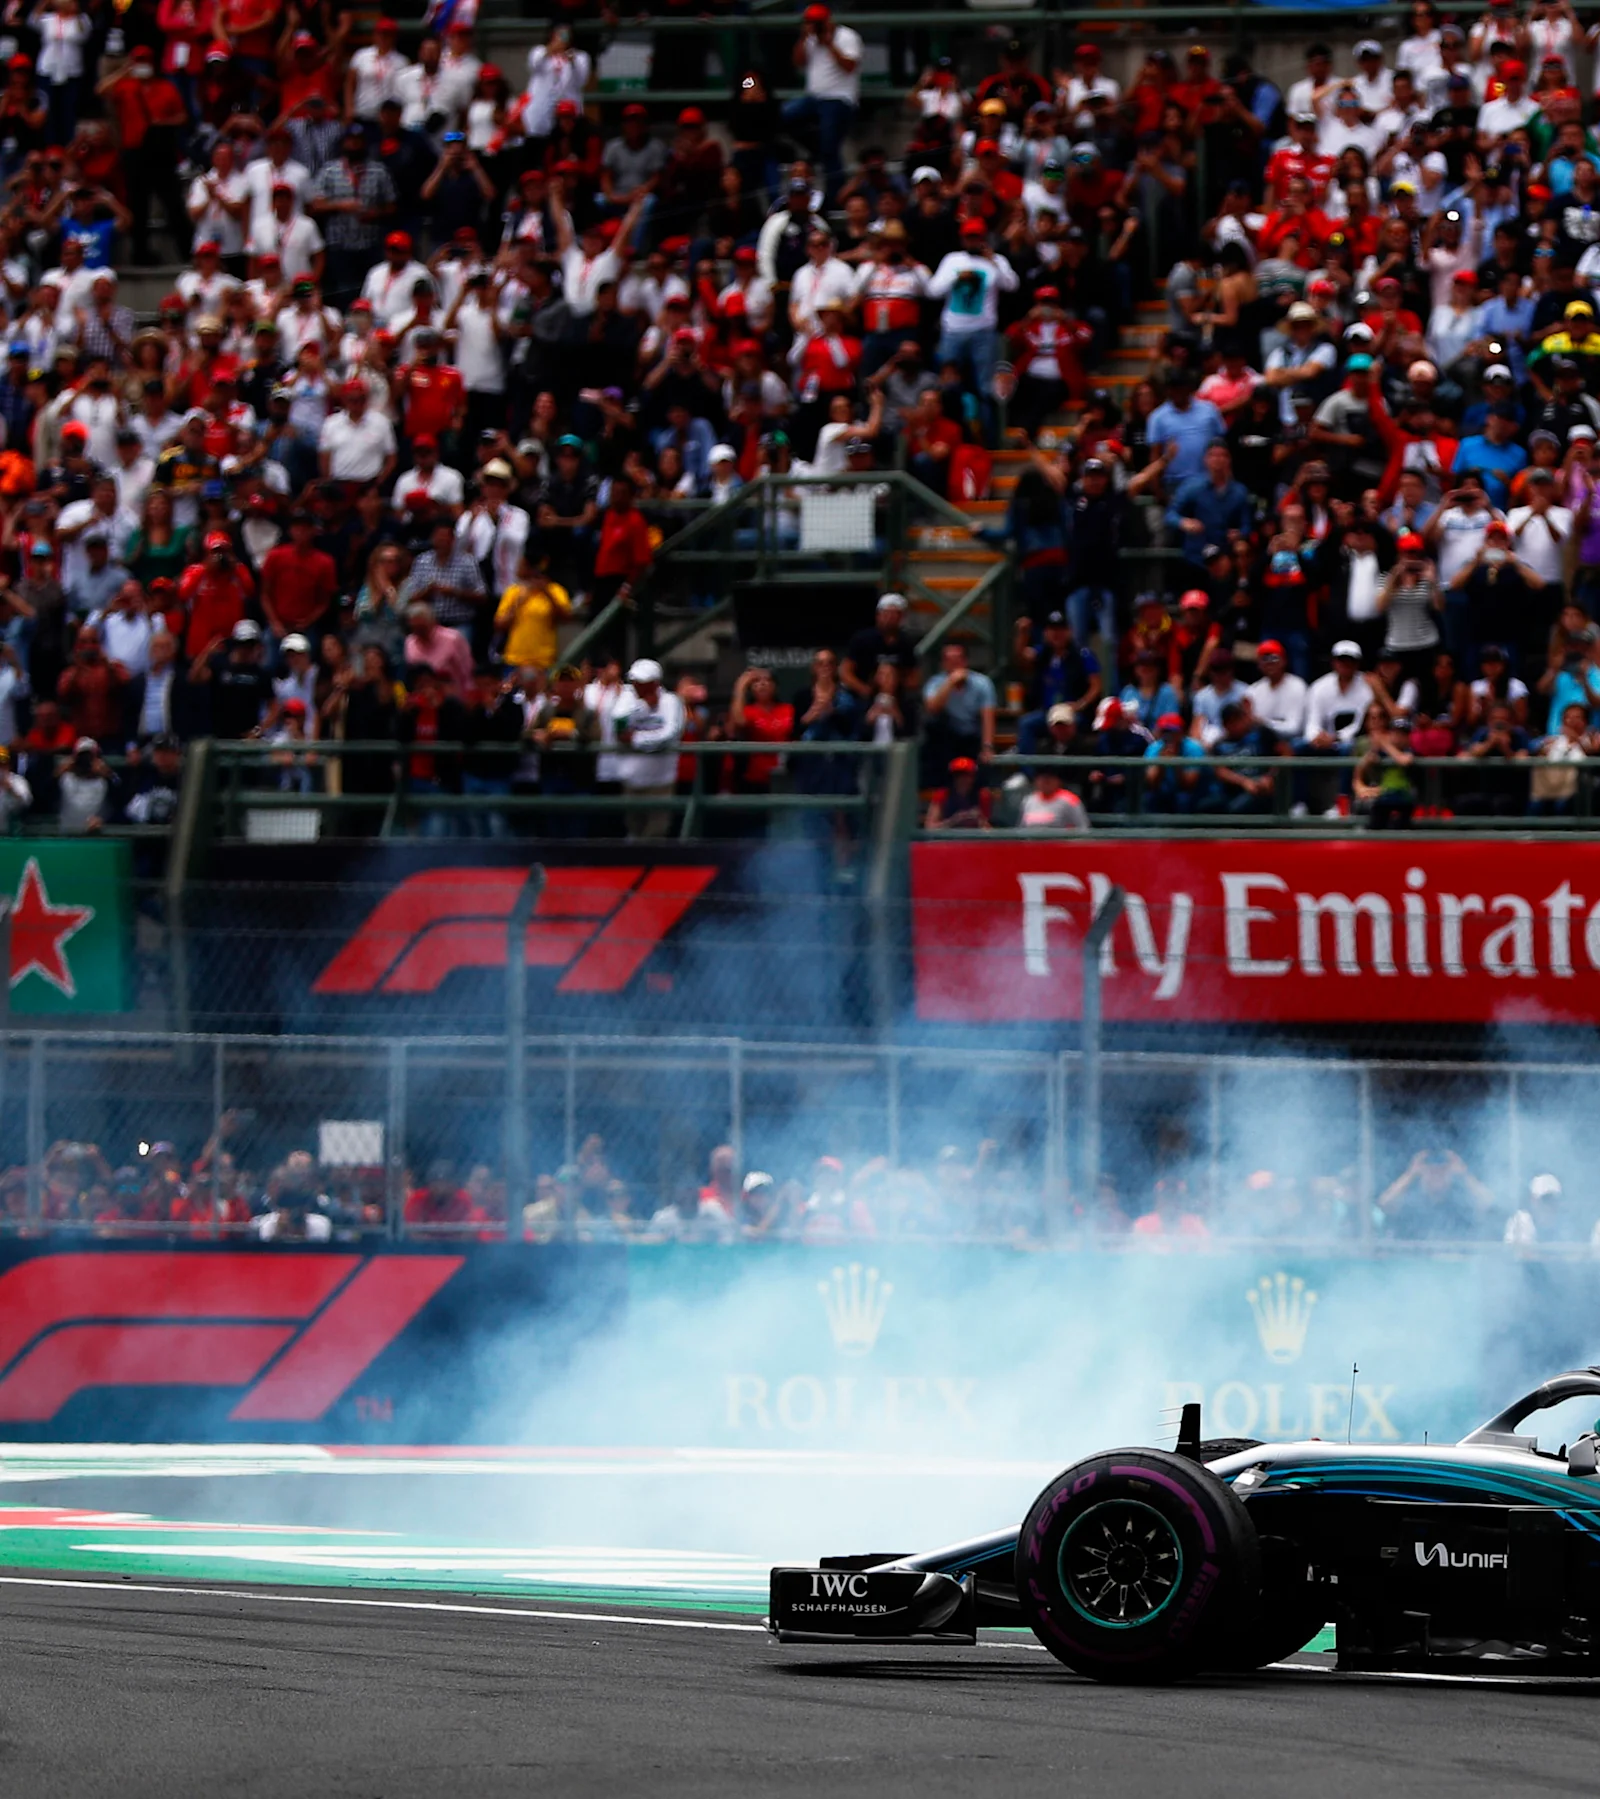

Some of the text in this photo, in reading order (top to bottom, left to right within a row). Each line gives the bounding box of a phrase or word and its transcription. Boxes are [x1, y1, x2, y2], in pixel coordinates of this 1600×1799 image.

[1018, 872, 1193, 1000] Fly
[726, 1374, 978, 1430] ROLEX
[1027, 1471, 1098, 1564] ZERO
[791, 1603, 887, 1614] SCHAFFHAUSEN
[810, 1574, 868, 1598] IWC
